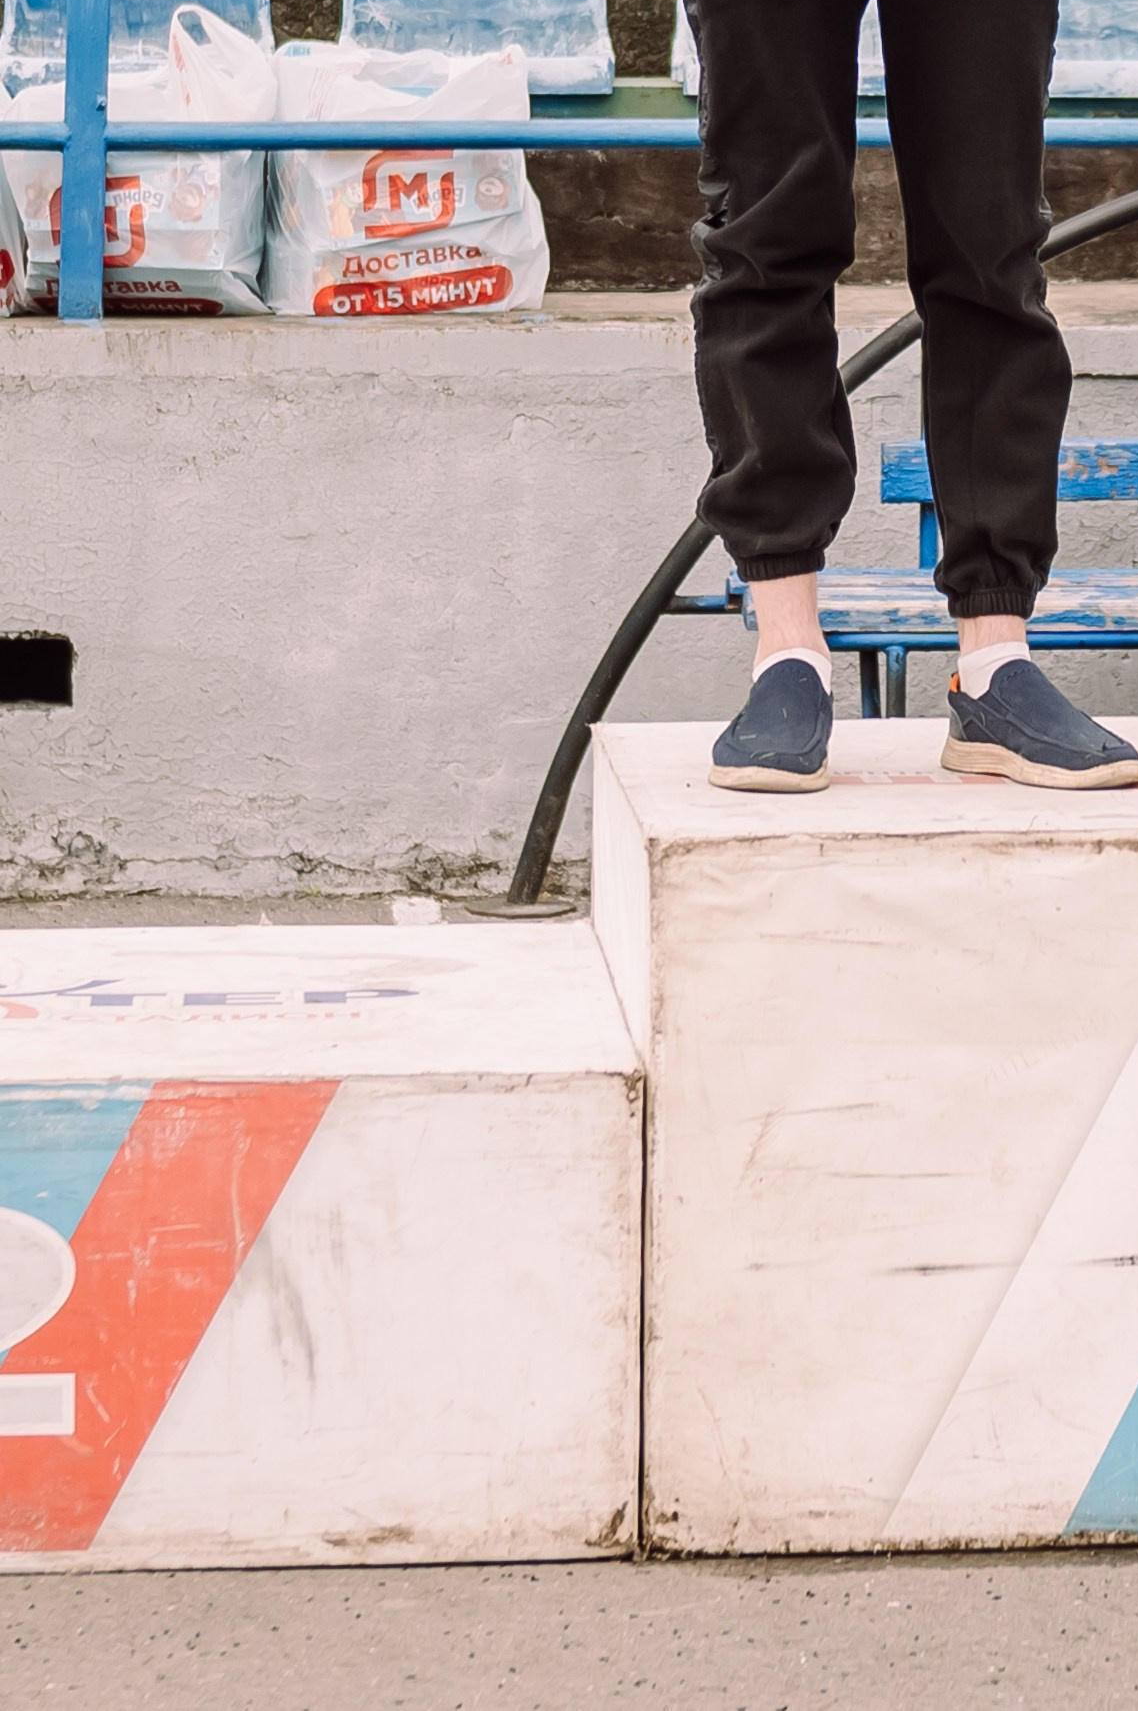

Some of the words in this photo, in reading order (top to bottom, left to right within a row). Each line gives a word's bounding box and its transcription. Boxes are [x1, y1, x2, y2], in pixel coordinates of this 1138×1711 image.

[342, 245, 482, 278] Доставка
[332, 293, 367, 314] от
[373, 286, 404, 309] 15
[411, 276, 497, 306] минут
[61, 1011, 362, 1023] СТАДИОН
